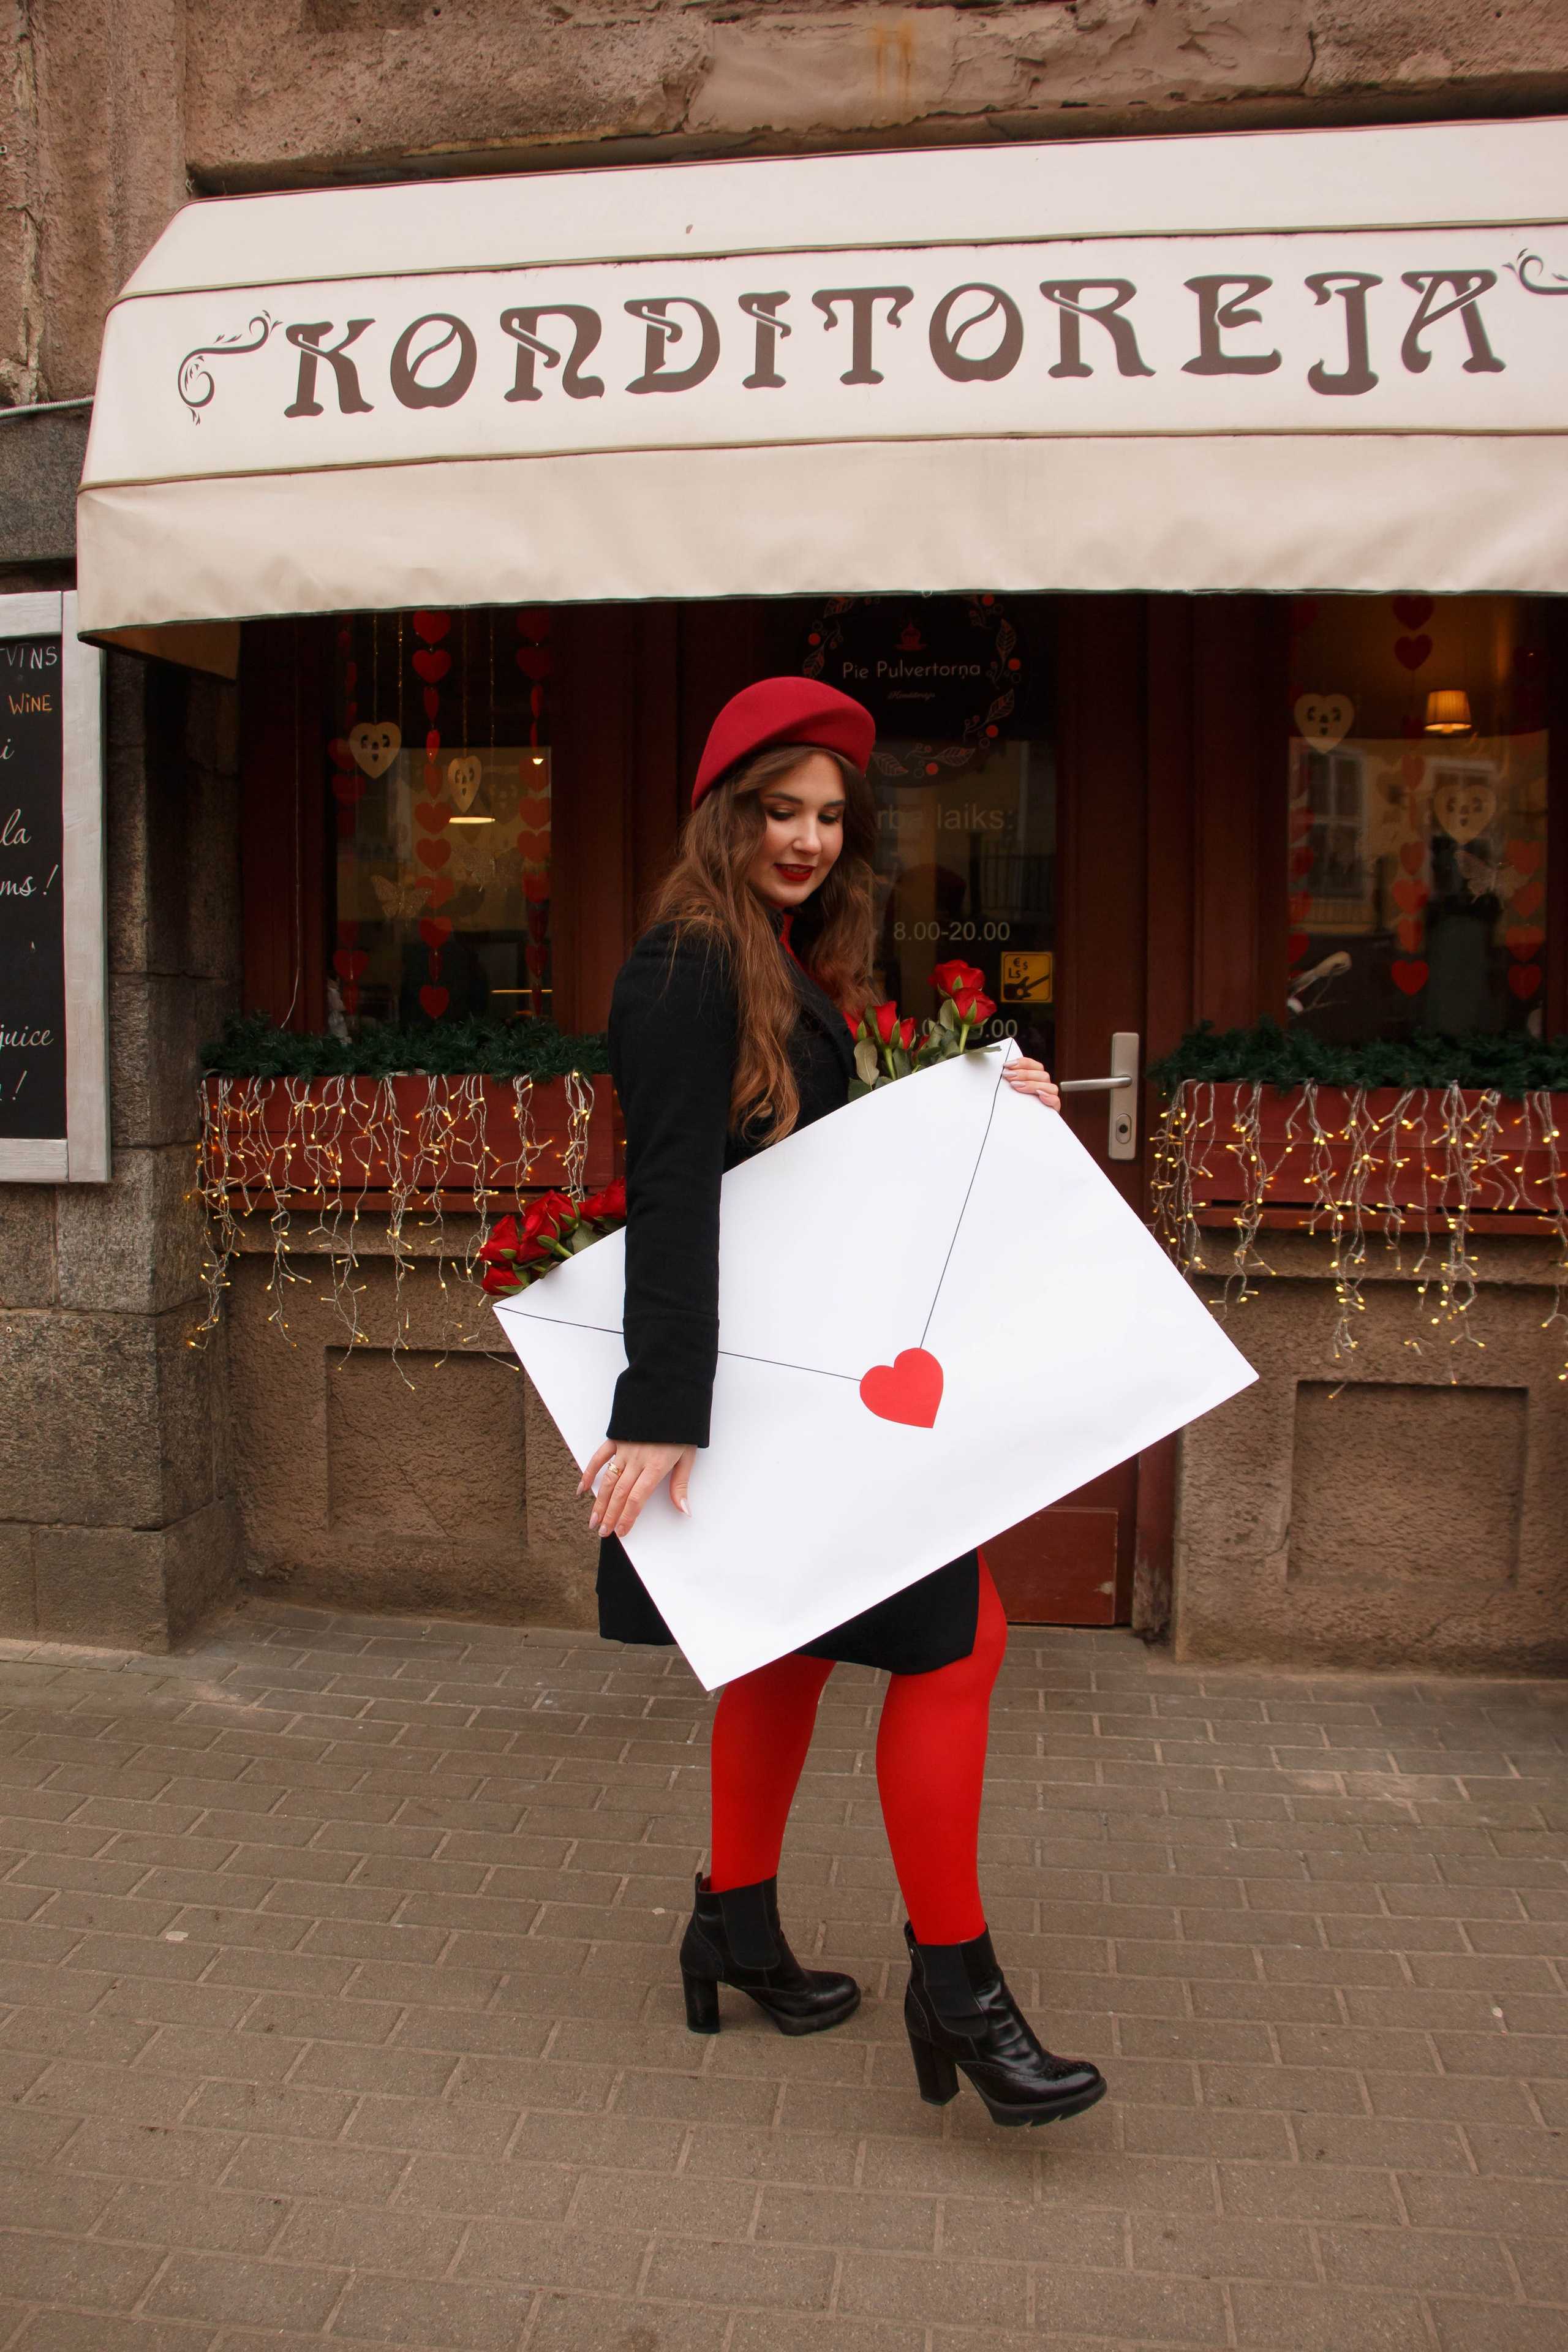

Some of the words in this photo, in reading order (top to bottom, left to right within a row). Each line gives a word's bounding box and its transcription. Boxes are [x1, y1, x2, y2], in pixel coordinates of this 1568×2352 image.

[284, 269, 1506, 418] KONDITOREJA
[842, 662, 869, 679] Pie
[876, 658, 981, 680] Pulvertorņa
[0, 808, 31, 846] la
[937, 804, 1013, 829] laiks:
[893, 921, 1011, 941] 8.00-20.00
